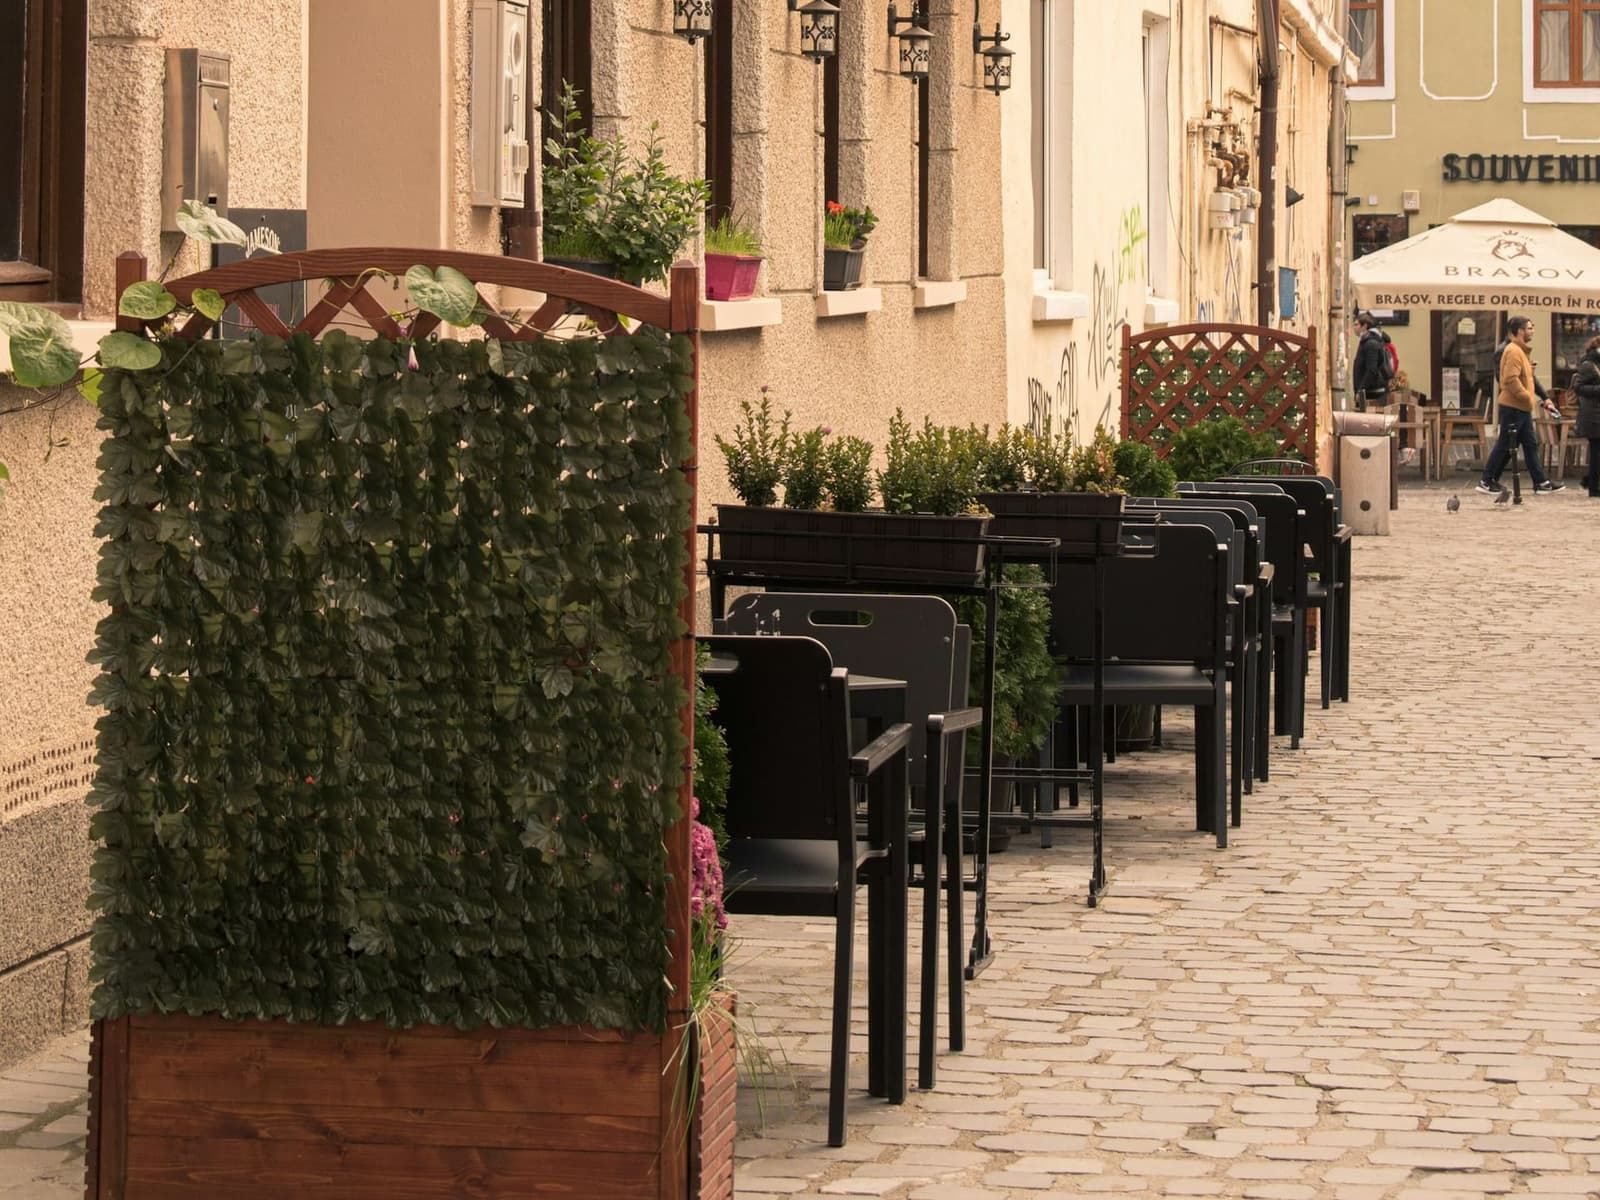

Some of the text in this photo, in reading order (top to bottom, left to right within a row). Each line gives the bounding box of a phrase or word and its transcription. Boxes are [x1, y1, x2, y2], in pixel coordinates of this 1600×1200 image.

[245, 226, 281, 259] JAMESON
[1444, 265, 1584, 280] BRAȘOV
[1375, 294, 1430, 307] BRAȘOV.
[1437, 294, 1485, 306] REGELE
[1490, 294, 1562, 310] ORAȘELOR
[1567, 294, 1581, 308] ÎN
